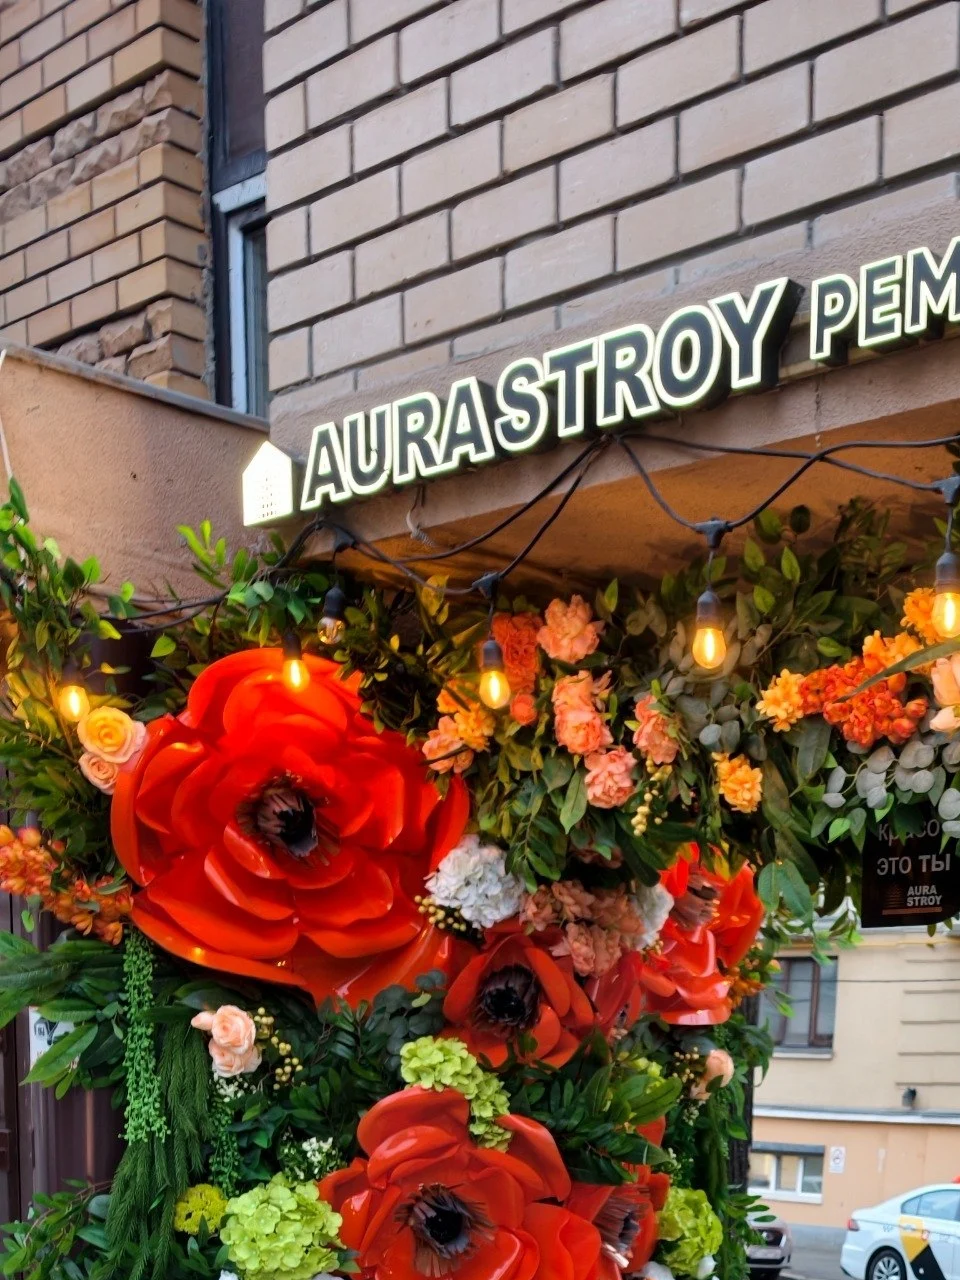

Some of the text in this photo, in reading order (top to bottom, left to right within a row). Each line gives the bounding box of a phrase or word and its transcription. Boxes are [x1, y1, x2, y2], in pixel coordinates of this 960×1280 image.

[300, 276, 789, 511] AURASTROY
[907, 885, 937, 896] AURA
[906, 895, 942, 907] STROY
